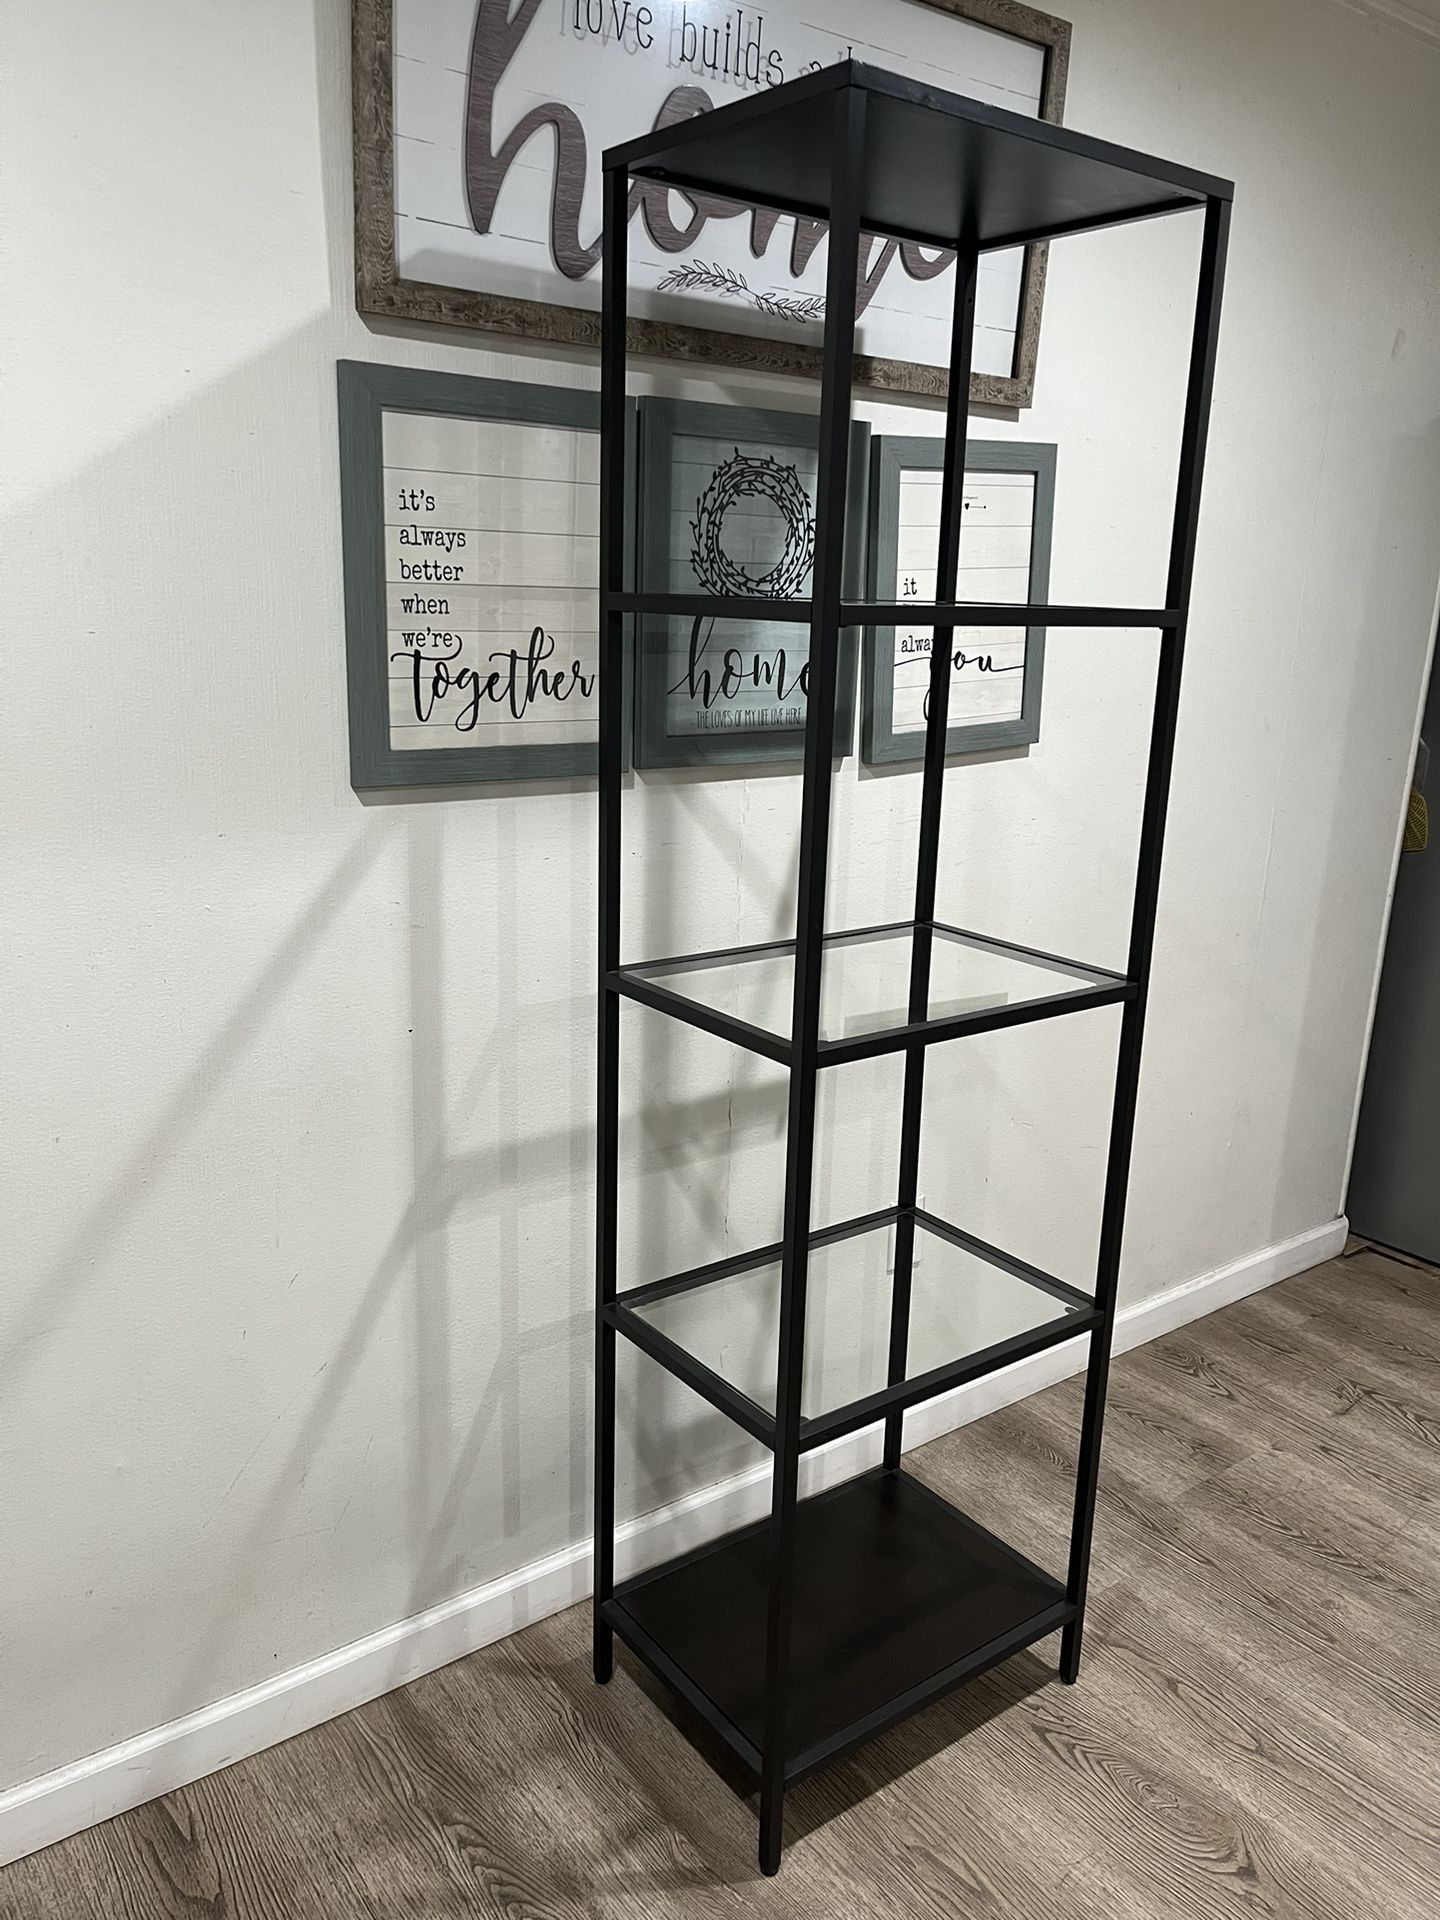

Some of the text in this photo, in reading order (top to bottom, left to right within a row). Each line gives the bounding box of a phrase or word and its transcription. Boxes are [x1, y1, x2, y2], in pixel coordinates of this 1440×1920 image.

[680, 2, 785, 87] builds
[465, 0, 957, 321] ho
[399, 489, 435, 511] it's
[400, 525, 466, 552] always
[400, 559, 463, 581] better
[903, 578, 917, 596] it
[401, 594, 450, 615] when
[402, 628, 453, 648] we're
[901, 635, 934, 653] alwa
[391, 626, 595, 732] together
[696, 706, 802, 729] THE LOVES OF MY LIFE LIVE HERE
